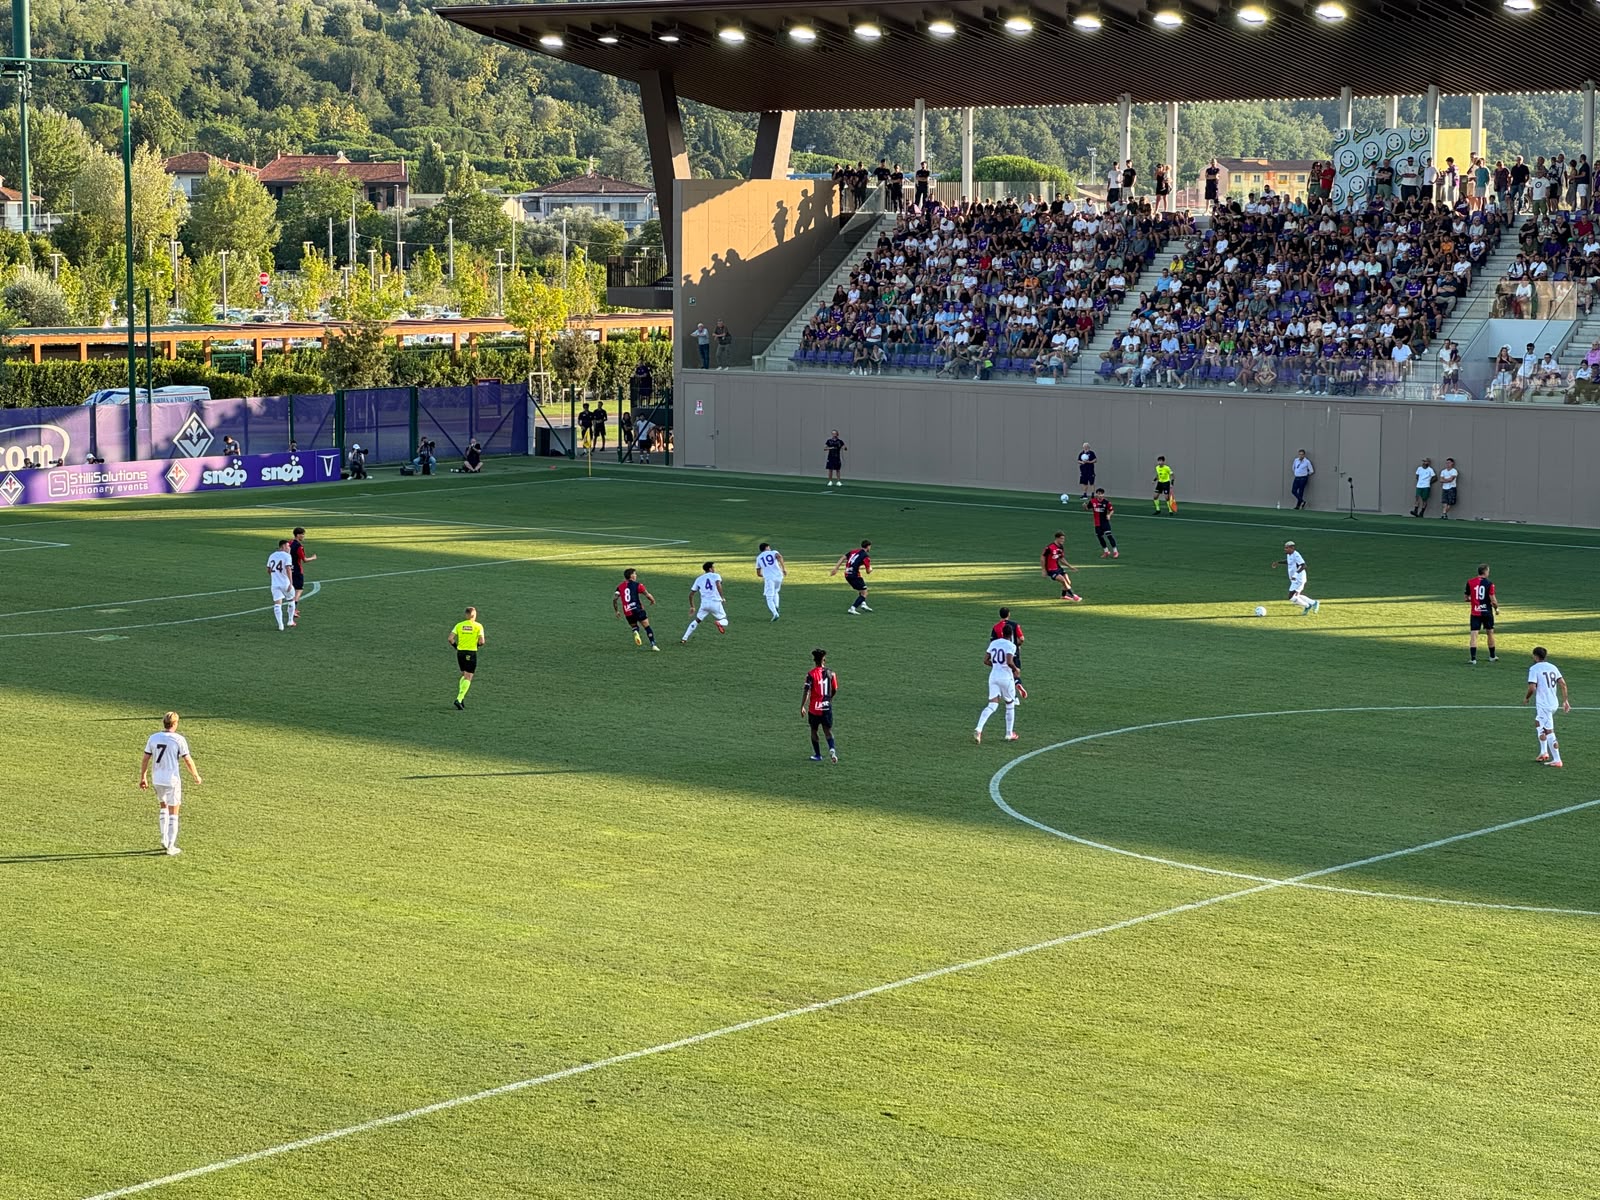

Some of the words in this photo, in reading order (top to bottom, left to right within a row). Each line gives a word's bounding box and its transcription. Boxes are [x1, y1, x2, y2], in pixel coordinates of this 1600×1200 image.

[0, 444, 53, 472] om
[70, 470, 148, 485] StilliSolutions
[70, 486, 114, 496] visionary
[117, 483, 149, 492] events
[270, 559, 284, 574] 24
[760, 554, 775, 568] 19
[704, 578, 713, 591] 4
[624, 587, 631, 603] 8
[1473, 585, 1486, 600] 19
[991, 647, 1005, 665] 20
[817, 677, 829, 696] 11
[1542, 671, 1557, 689] 18
[156, 743, 167, 763] 7
